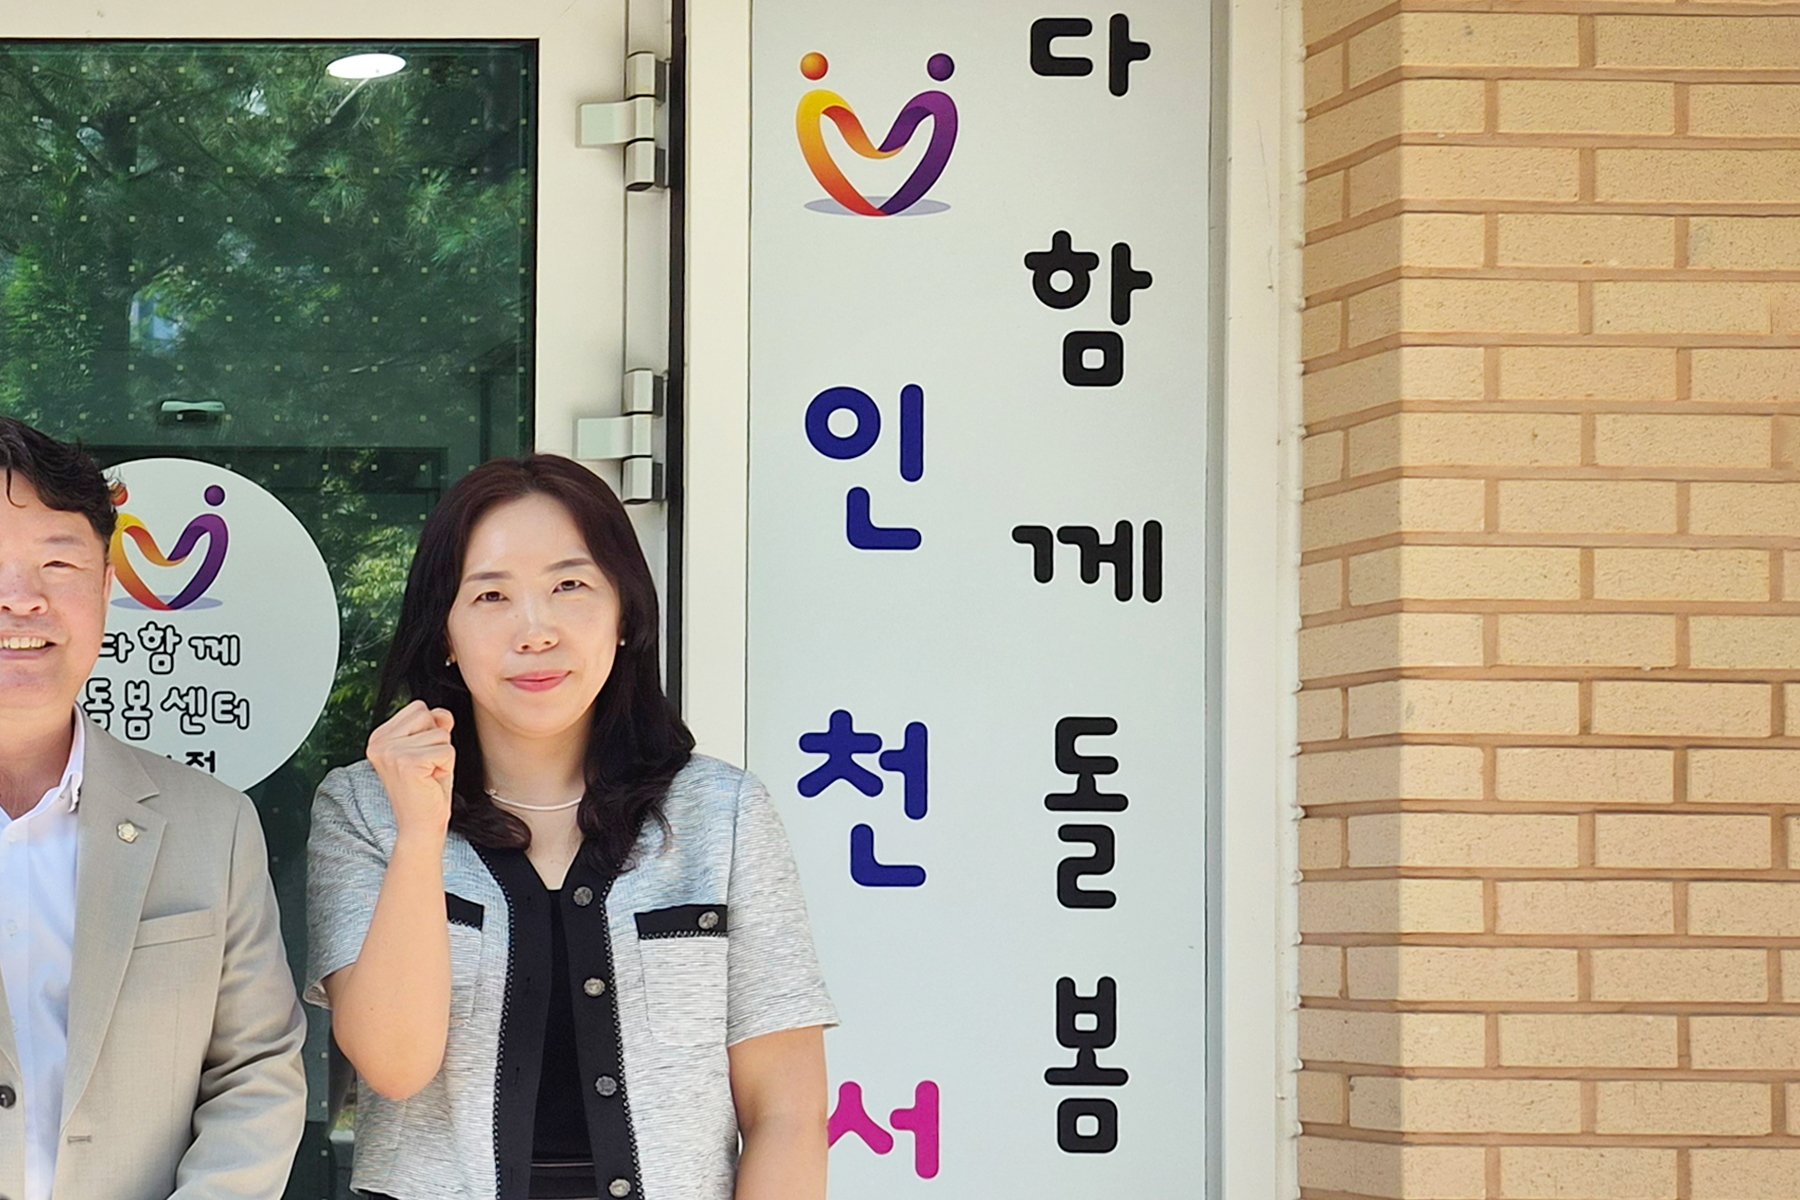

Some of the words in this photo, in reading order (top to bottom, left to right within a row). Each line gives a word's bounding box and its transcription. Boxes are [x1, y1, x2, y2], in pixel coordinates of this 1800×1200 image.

[99, 621, 241, 675] 다함께
[797, 383, 928, 888] 인천
[82, 677, 250, 741] 돌봄센터
